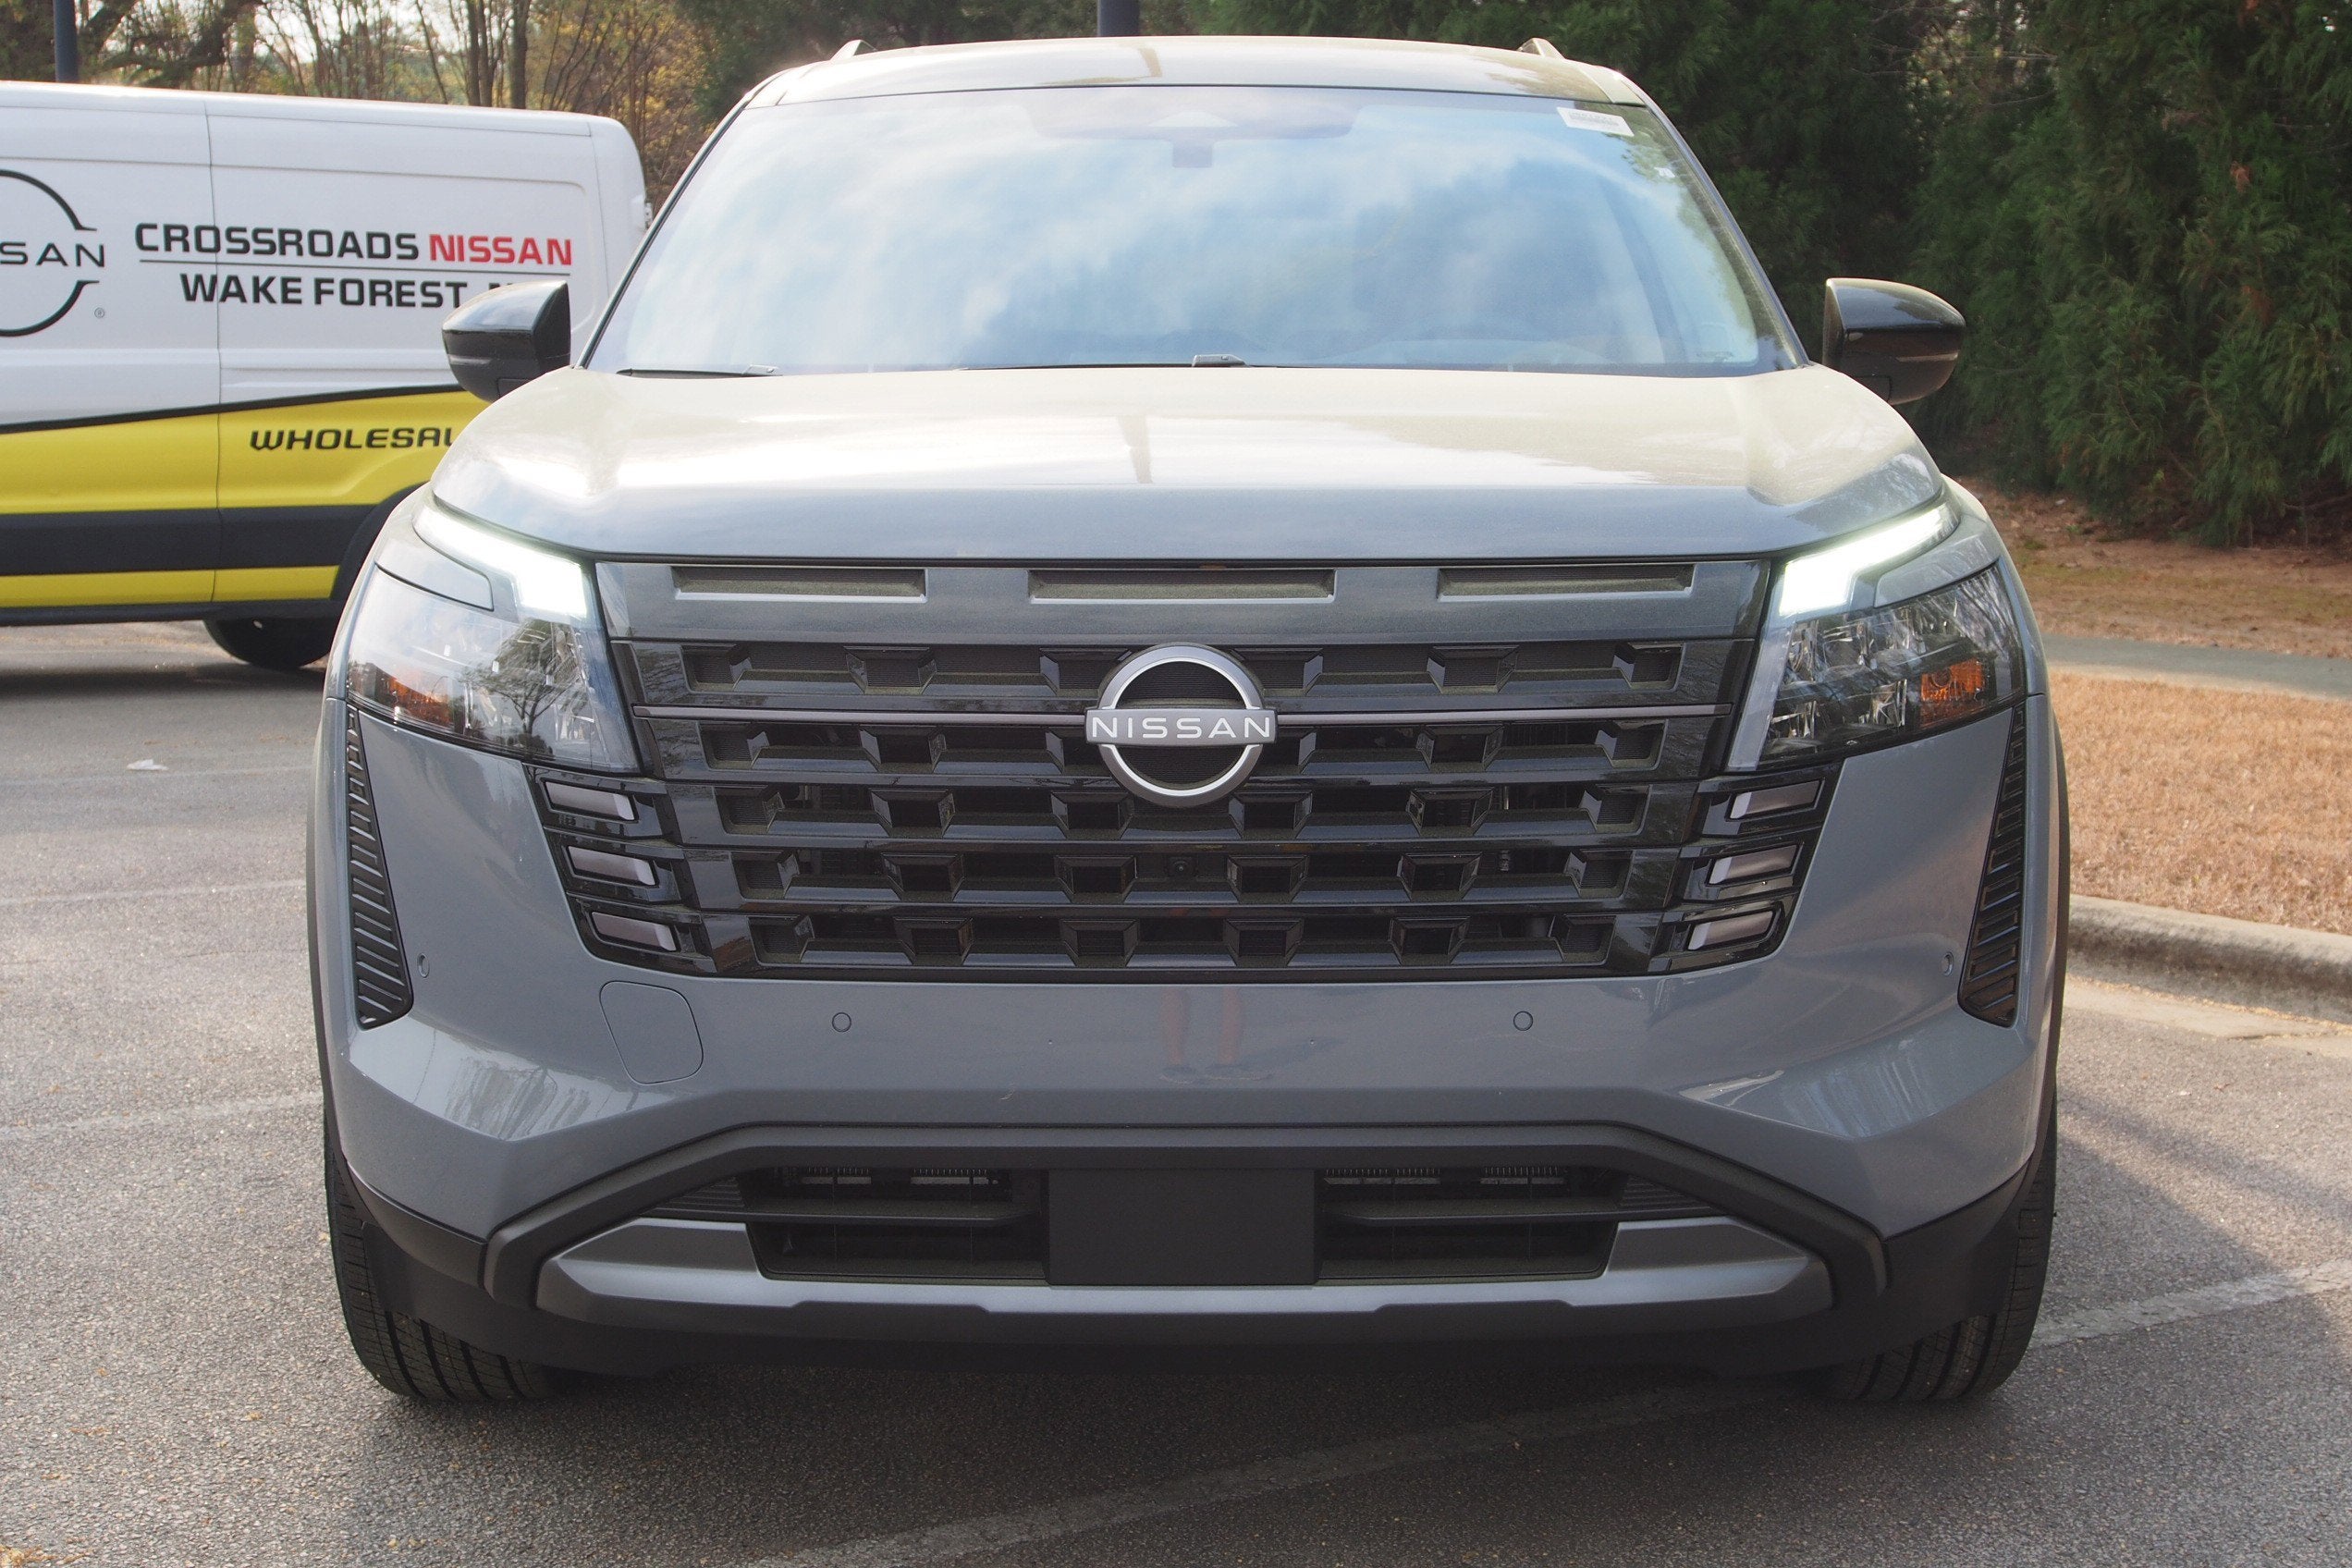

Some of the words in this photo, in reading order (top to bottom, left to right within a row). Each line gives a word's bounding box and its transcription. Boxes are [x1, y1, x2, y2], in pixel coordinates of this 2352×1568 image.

[135, 222, 420, 261] CROSSROADS
[429, 234, 572, 266] NISSAN
[180, 273, 302, 305] WAKE
[313, 280, 469, 309] FOREST
[1092, 717, 1270, 739] NISSAN
